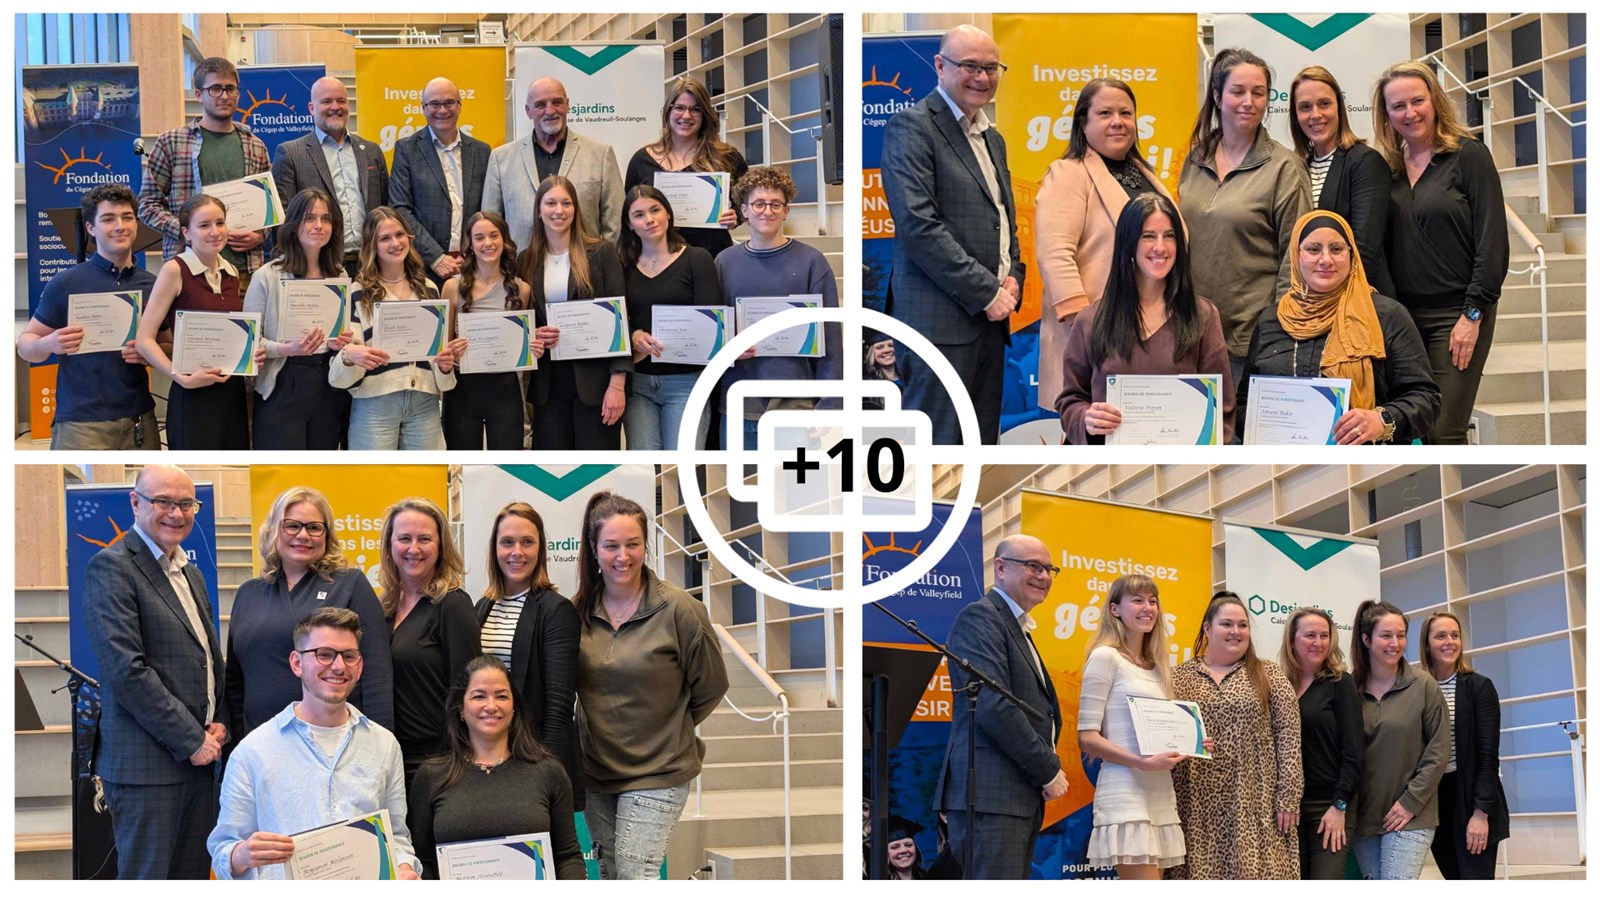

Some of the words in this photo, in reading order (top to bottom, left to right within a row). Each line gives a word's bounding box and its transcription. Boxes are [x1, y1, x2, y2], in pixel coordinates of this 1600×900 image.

[1033, 64, 1158, 82] Investissez
[384, 87, 475, 100] Invesez
[1060, 87, 1079, 102] da
[403, 103, 424, 115] da
[567, 102, 615, 116] sjardins
[862, 98, 915, 115] ondati
[1268, 106, 1290, 114] Caiss
[252, 112, 313, 125] Fondation
[1027, 107, 1157, 152] gés
[65, 171, 130, 185] Fondation
[40, 258, 77, 266] Contributi
[1062, 550, 1178, 581] Investissez
[866, 564, 961, 587] Foation
[907, 588, 917, 596] de
[920, 588, 962, 599] Valleyfield
[1054, 596, 1177, 640] gés
[1062, 864, 1091, 873] POUR
